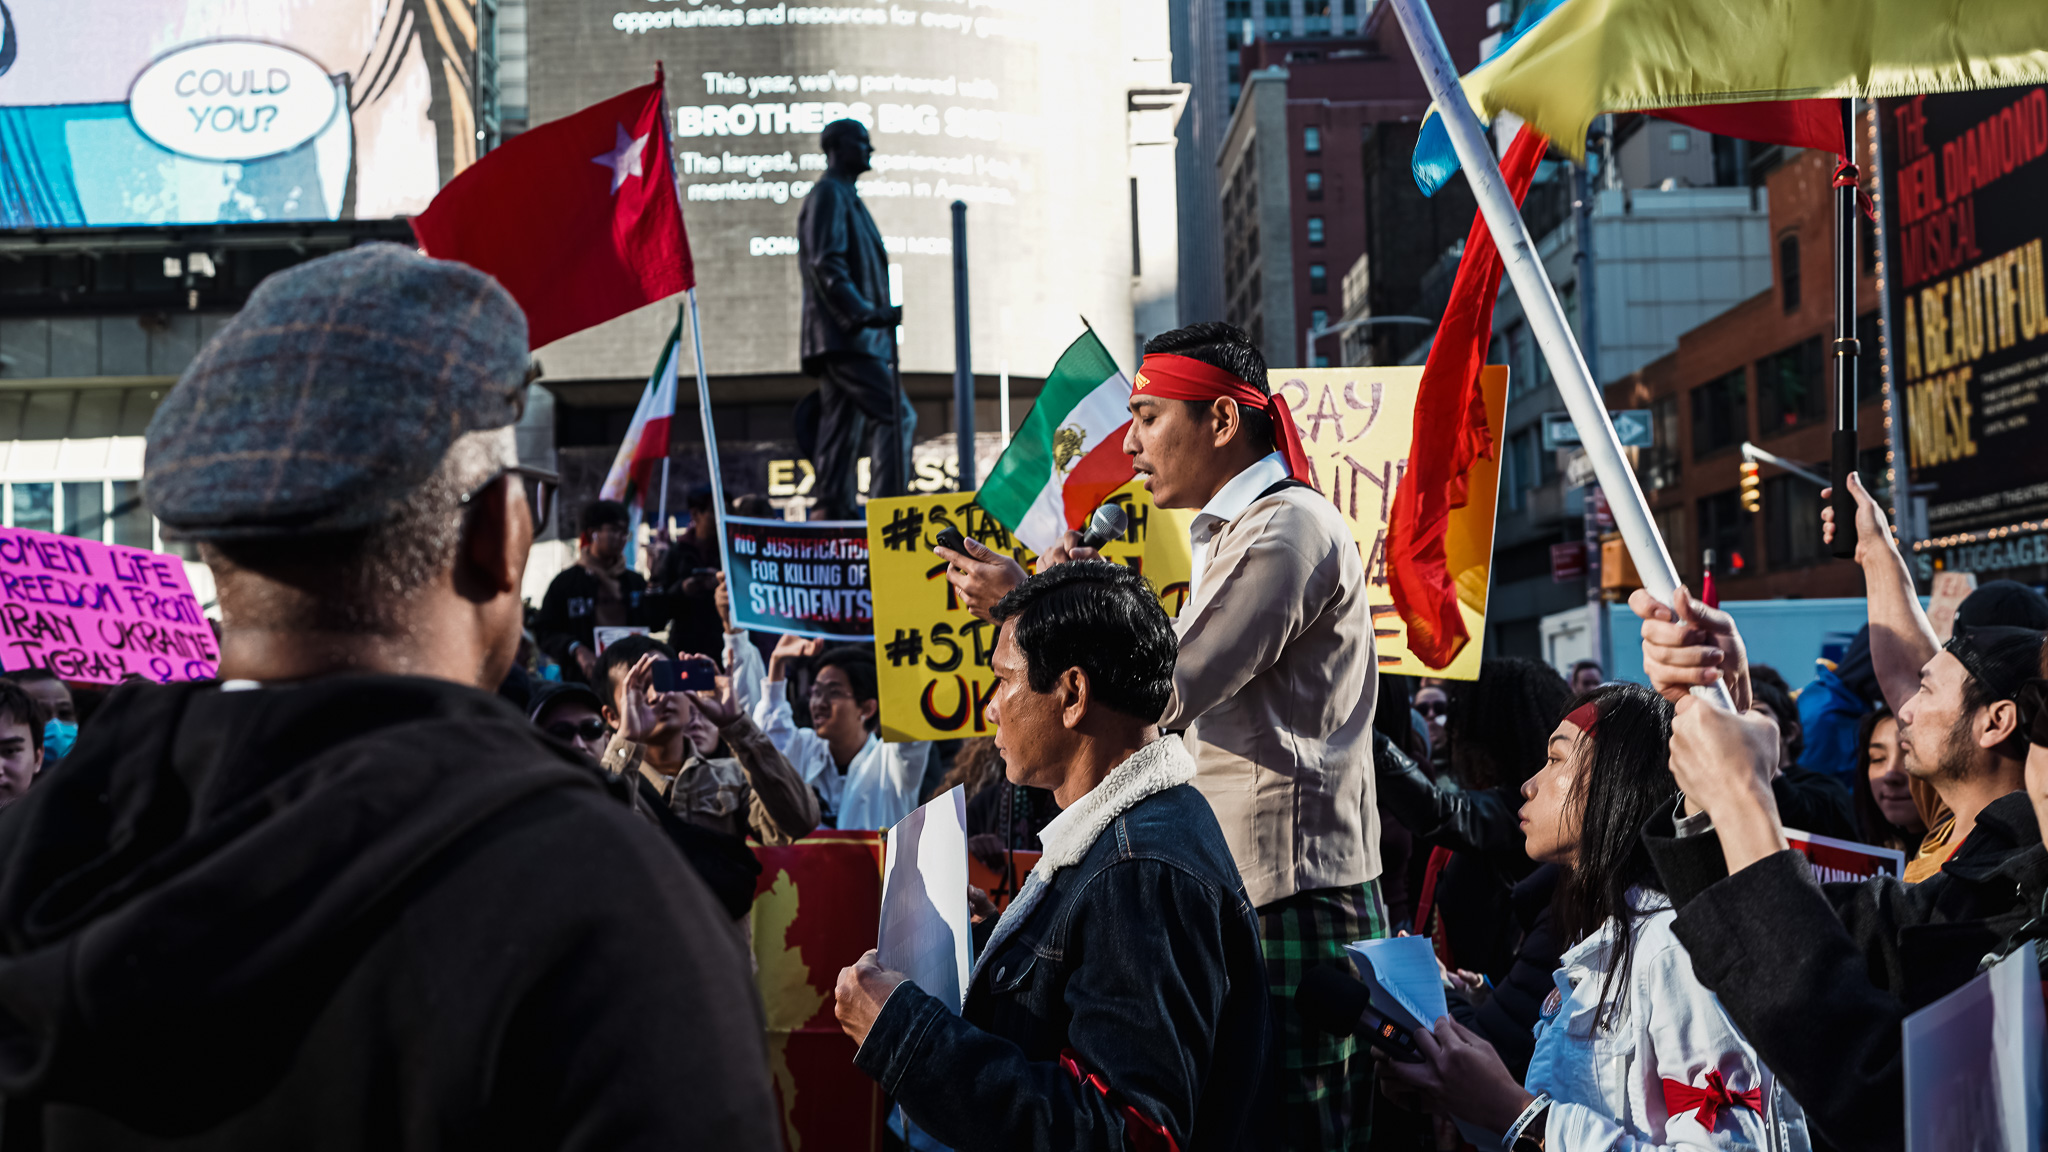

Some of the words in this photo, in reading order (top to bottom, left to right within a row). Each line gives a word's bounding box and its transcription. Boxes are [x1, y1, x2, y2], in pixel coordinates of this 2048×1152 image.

[612, 4, 745, 34] opportunities
[746, 2, 786, 25] and
[788, 6, 887, 25] resources
[890, 4, 917, 26] for
[175, 68, 291, 98] COULD
[702, 71, 747, 95] This
[748, 75, 797, 99] year,
[798, 70, 858, 92] we've
[187, 104, 279, 133] YOU?
[677, 102, 873, 137] BROTHERS
[878, 103, 940, 134] BIG
[1894, 93, 1931, 168] THE
[680, 151, 720, 174] The
[721, 150, 798, 177] largest,
[1898, 152, 1942, 228] NEIL
[1942, 88, 2048, 203] DIAMOND
[687, 179, 789, 204] mentoring
[1901, 195, 1981, 288] MUSICAL
[1905, 296, 1922, 381] A
[1921, 238, 2048, 375] BEAUTIFUL
[1907, 366, 1977, 469] NOISE
[0, 535, 93, 576] OMEN
[734, 534, 757, 555] NO
[762, 536, 869, 559] JUSTIFICATIO
[1945, 534, 2048, 573] LUGGAGE
[751, 559, 779, 582] FOR
[784, 562, 842, 585] KILLING
[847, 564, 868, 586] OF
[0, 570, 124, 614] REEDOM
[123, 585, 203, 625] FROM
[748, 582, 873, 622] STUDENTS
[0, 602, 82, 646] IRAN
[98, 618, 218, 661] UKRAINE
